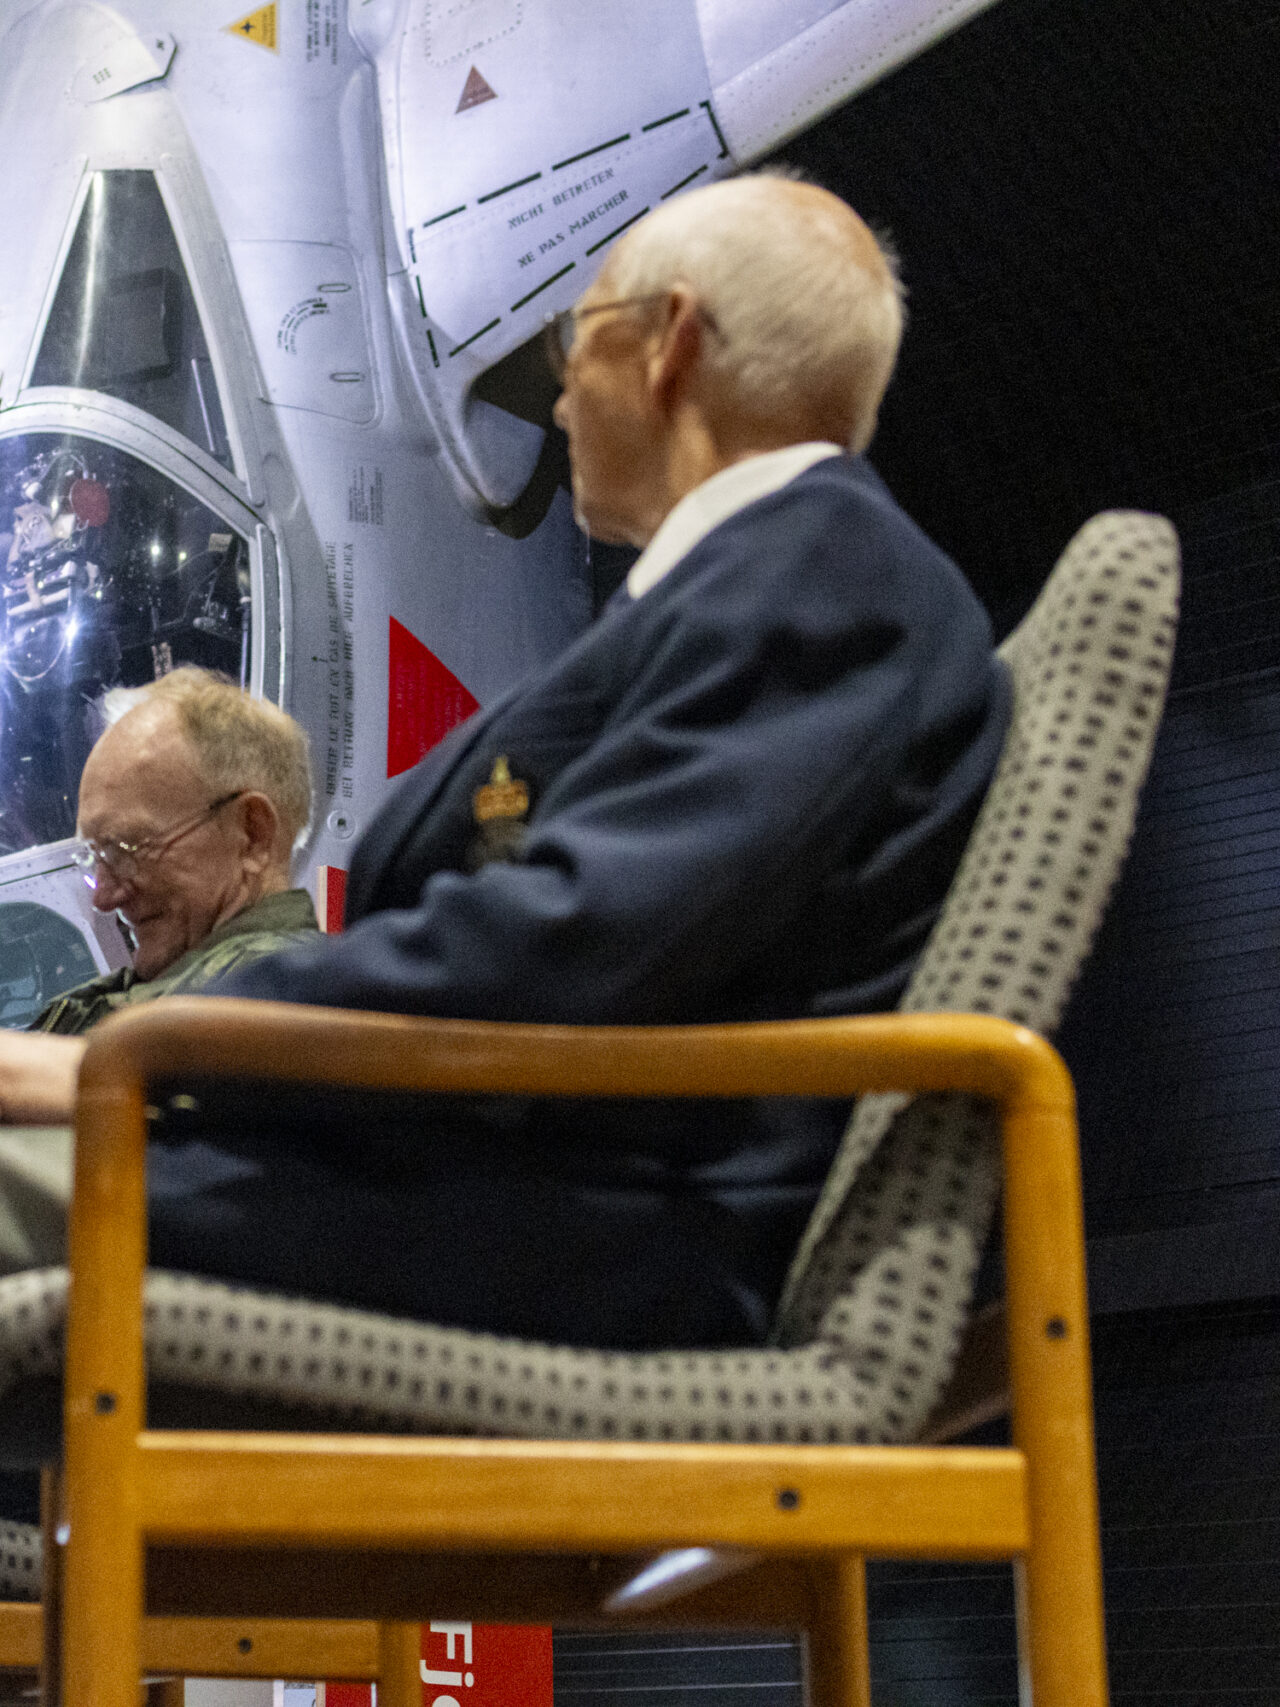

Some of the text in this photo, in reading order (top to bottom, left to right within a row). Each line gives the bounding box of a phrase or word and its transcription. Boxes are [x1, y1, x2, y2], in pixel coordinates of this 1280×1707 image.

[507, 167, 615, 230] NICHT BETRETEN
[517, 189, 629, 269] NE PAS MARCHER
[328, 639, 338, 664] CAS
